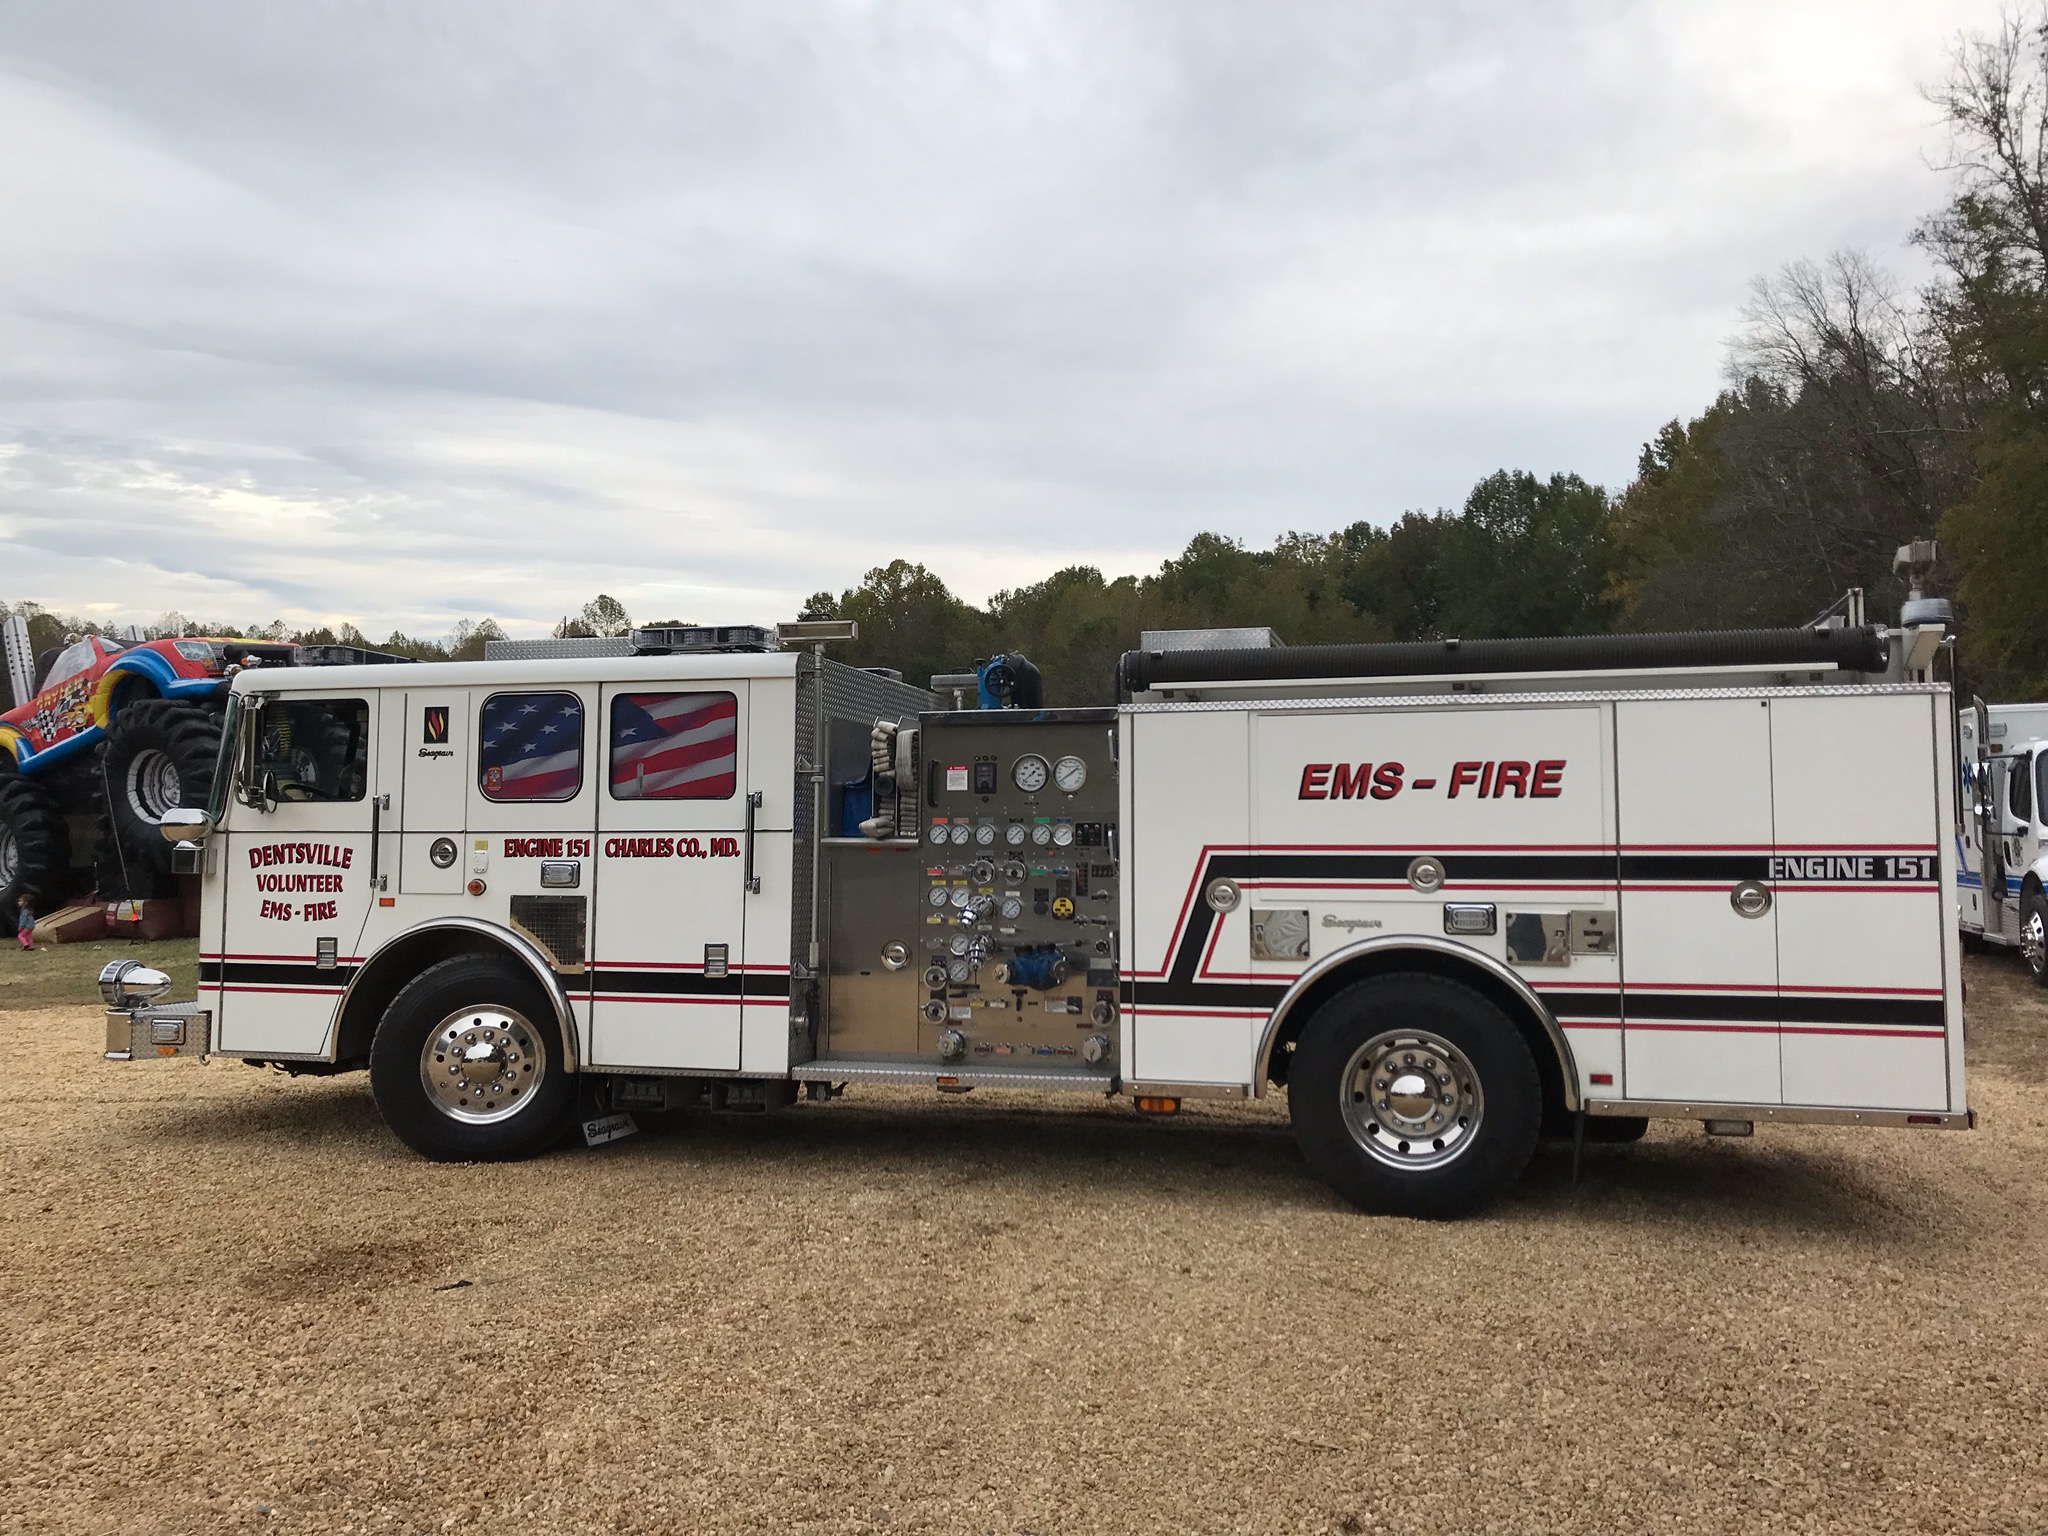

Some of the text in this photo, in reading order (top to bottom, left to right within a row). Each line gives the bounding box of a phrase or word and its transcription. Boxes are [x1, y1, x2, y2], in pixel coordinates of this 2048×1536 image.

[1298, 762, 1404, 800] EMS
[1447, 760, 1567, 799] FIRE
[248, 842, 354, 870] DENTSVILLE
[504, 838, 563, 858] ENGINE
[565, 838, 591, 858] 151
[605, 837, 741, 859] CHARLES CO., MD.
[1768, 857, 1931, 879] ENGINE 151
[256, 874, 344, 893] VOLUNTEER
[260, 899, 292, 922] EMS
[303, 899, 338, 922] FIRE
